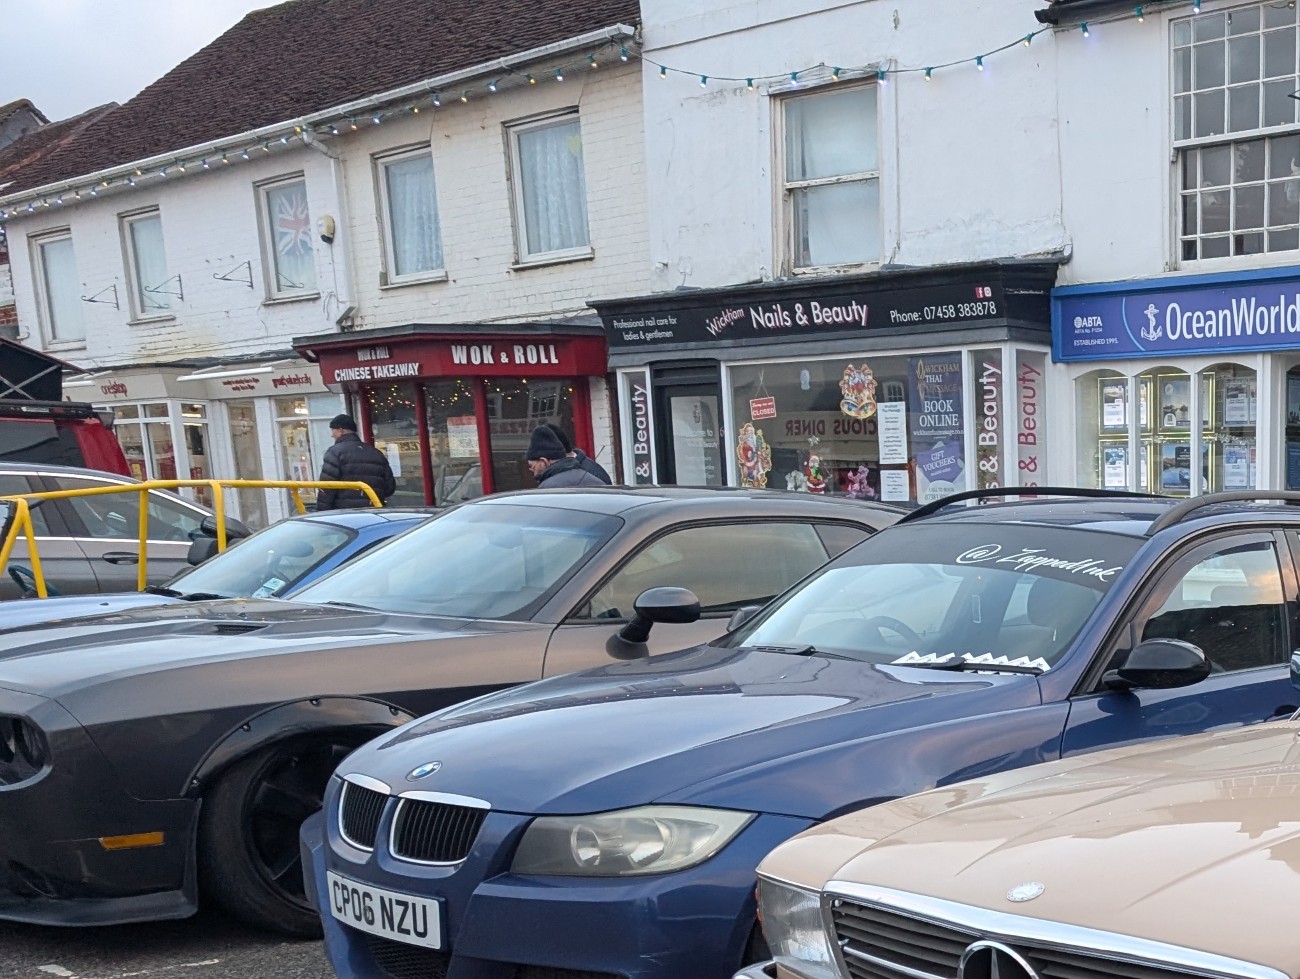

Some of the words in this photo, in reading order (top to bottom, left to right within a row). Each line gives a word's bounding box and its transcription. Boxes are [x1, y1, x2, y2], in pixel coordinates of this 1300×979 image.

[706, 307, 745, 337] Wickham
[749, 303, 792, 328] Nails
[795, 303, 809, 325] &
[810, 300, 868, 327] Beauty
[890, 310, 922, 323] Phone:
[923, 304, 956, 319] 07458
[958, 301, 997, 317] 383878
[613, 317, 645, 329] Professional
[645, 317, 656, 327] nail
[656, 318, 668, 326] care
[668, 315, 677, 325] for
[1082, 316, 1103, 327] ABTA
[623, 331, 639, 341] ladies
[639, 331, 645, 340] &
[645, 329, 673, 341] gentlemen
[1074, 338, 1106, 347] ESTABLISHED
[358, 348, 371, 361] WOK
[376, 346, 390, 359] ROLL
[451, 345, 494, 365] WOK
[501, 352, 509, 363] &
[514, 345, 559, 364] ROLL
[335, 366, 372, 382] CHINESE
[372, 363, 420, 378] TAKEAWAY
[925, 363, 960, 374] WICKHAM
[925, 374, 942, 383] THAI
[924, 400, 954, 413] BOOK
[979, 362, 1001, 445] Beauty
[1018, 363, 1041, 445] Beauty
[753, 407, 775, 416] CLOSED
[631, 384, 648, 455] Beauty
[919, 414, 960, 427] ONLINE
[931, 450, 945, 461] GIFT
[635, 462, 650, 478] &
[922, 456, 956, 471] VOUCHERS
[980, 456, 998, 472] &
[1018, 456, 1037, 472] &
[332, 880, 374, 926] CP06
[379, 895, 427, 939] NZU
